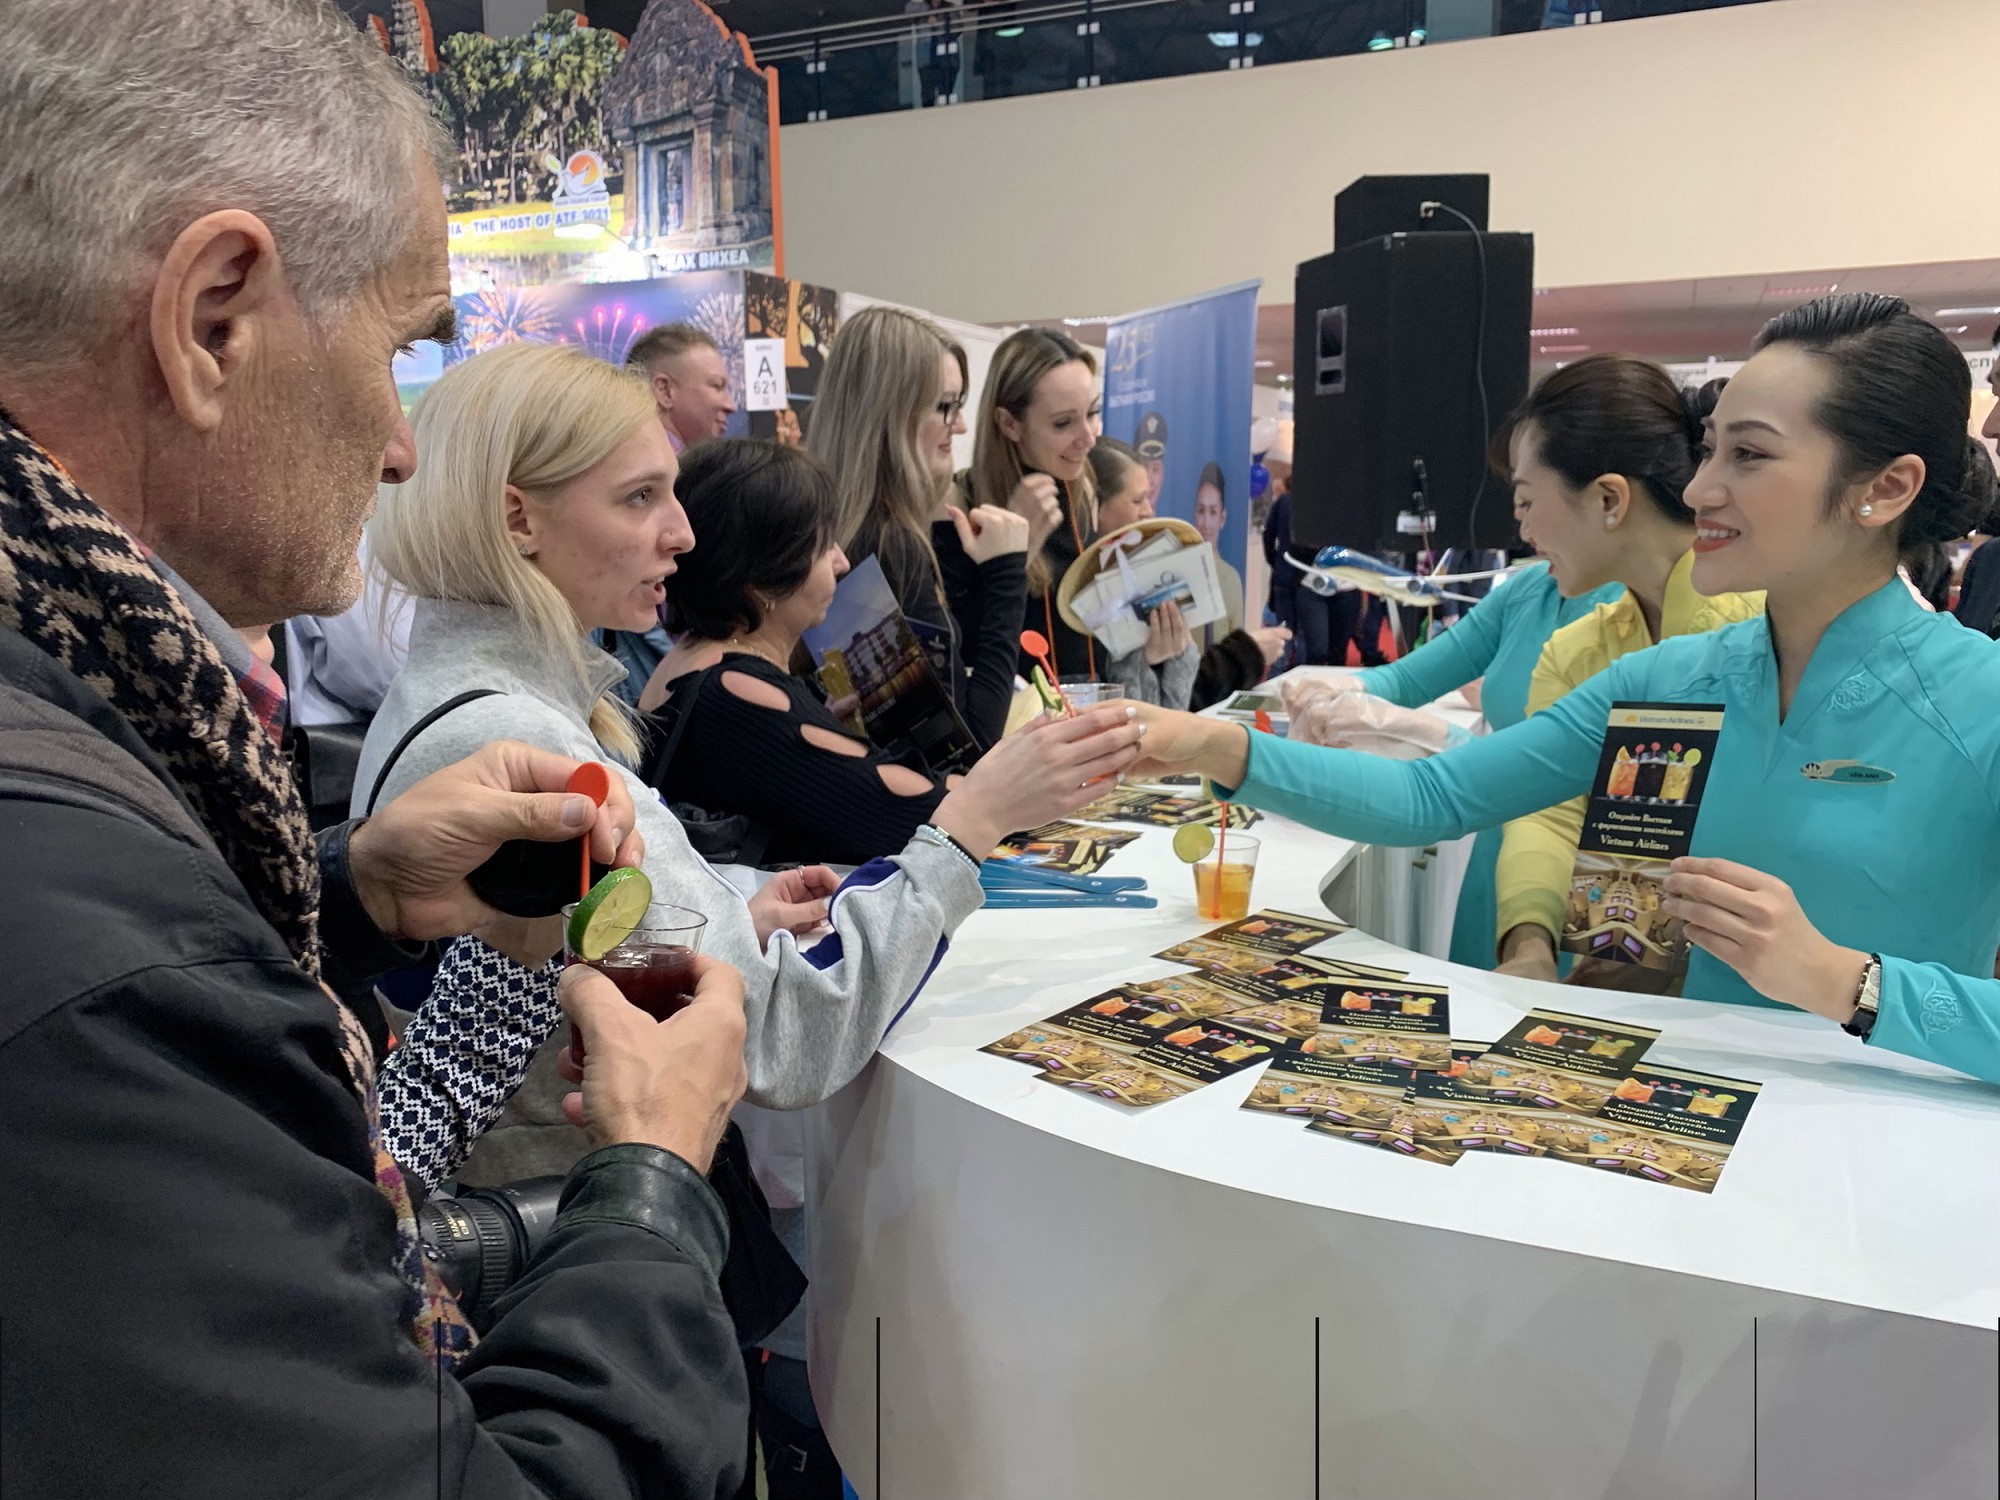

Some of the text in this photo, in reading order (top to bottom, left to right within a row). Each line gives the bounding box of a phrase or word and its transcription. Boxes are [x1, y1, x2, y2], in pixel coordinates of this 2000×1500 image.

[473, 220, 496, 233] THE
[500, 215, 531, 231] HOST
[535, 213, 551, 228] OF
[699, 248, 750, 270] ВИХЕА
[758, 356, 773, 377] A
[753, 380, 777, 395] 621
[1344, 1019, 1426, 1032] Vietnam Airlines
[1514, 1051, 1600, 1074] Vietnam Airlines
[1295, 1065, 1382, 1082] Vietnam Airlines
[1443, 1091, 1491, 1102] Vietnam
[1607, 1111, 1707, 1138] Vietnam Airlines
